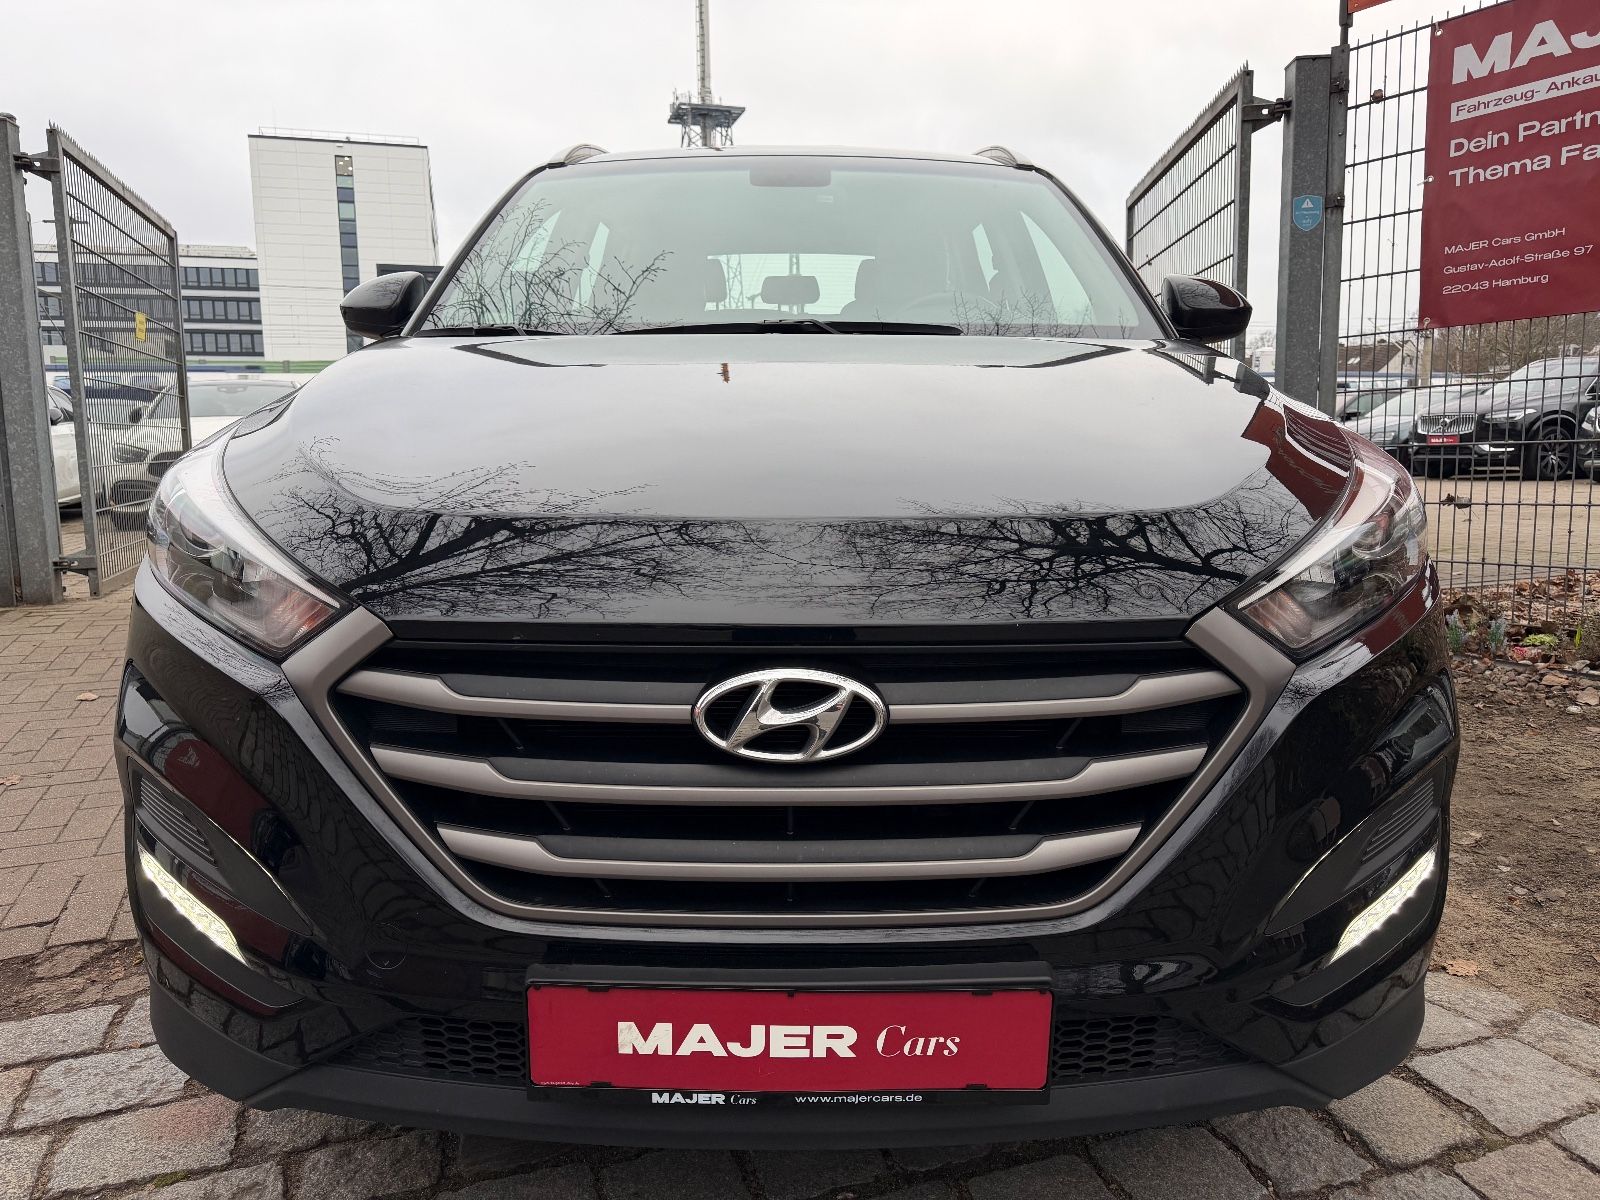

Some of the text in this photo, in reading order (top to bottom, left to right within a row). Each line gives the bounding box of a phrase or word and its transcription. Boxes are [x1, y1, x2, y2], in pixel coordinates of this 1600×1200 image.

[1455, 89, 1541, 117] Fahrzeug-
[1450, 110, 1600, 158] Dein Partn
[1449, 143, 1600, 187] Thema Fa
[1444, 227, 1566, 255] MAJER Cars GmbH
[1443, 245, 1594, 275] Gustav-Adolf-Straße 97
[1442, 274, 1549, 295] 22043 Hamburg
[617, 1021, 961, 1058] MAJER Cars
[651, 1092, 757, 1105] MAJER Cars
[794, 1093, 923, 1105] www.majercars.de
